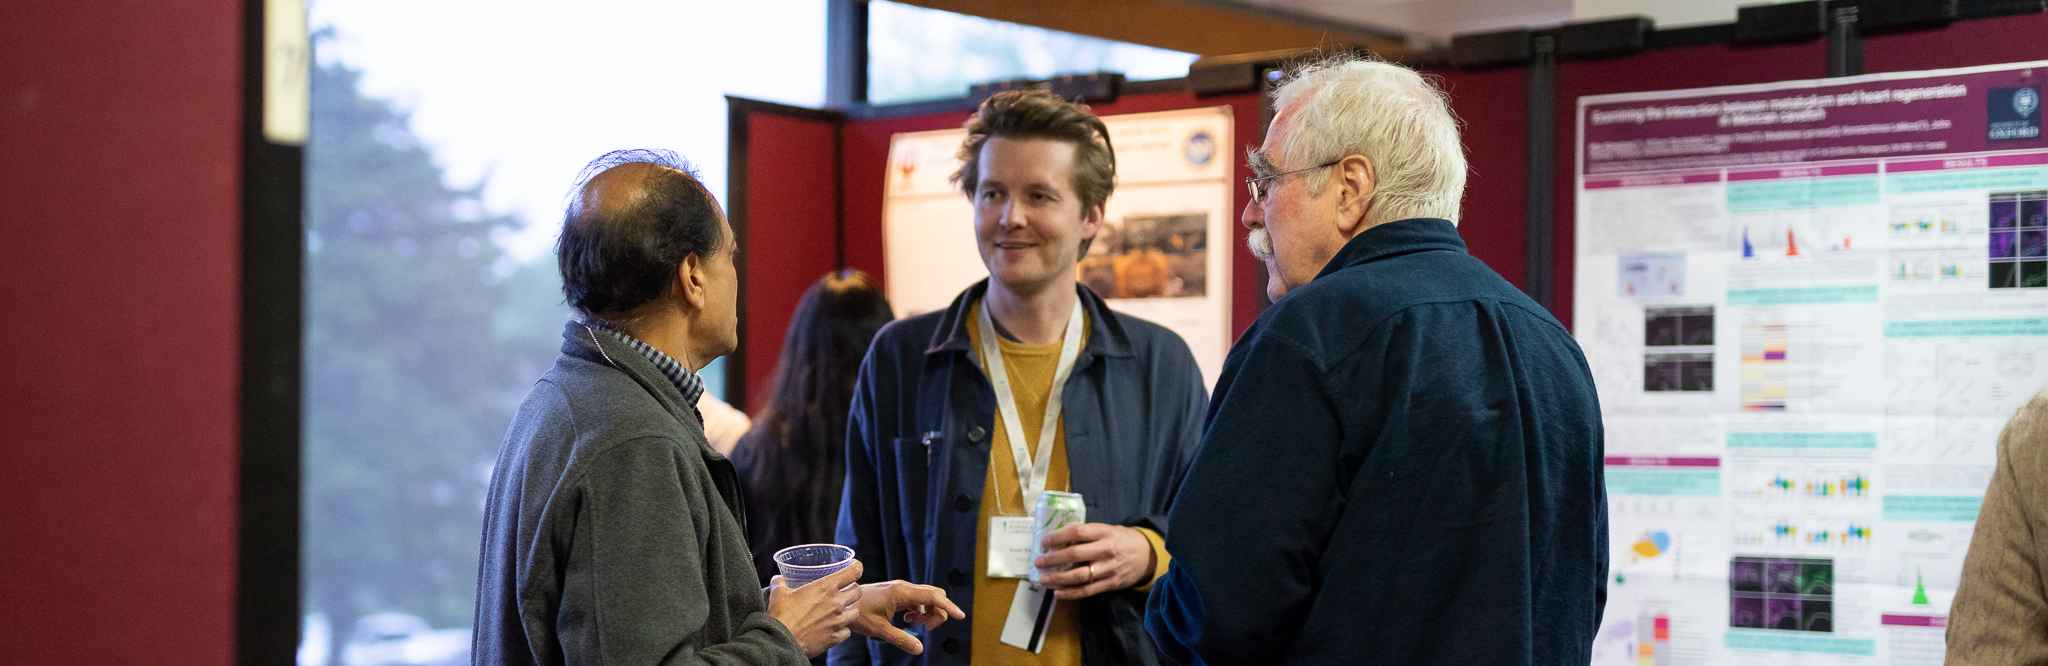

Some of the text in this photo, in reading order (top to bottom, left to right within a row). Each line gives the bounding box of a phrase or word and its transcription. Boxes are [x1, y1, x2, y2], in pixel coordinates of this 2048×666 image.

[1646, 106, 1663, 121] the
[1722, 100, 1769, 116] between
[1836, 91, 1858, 107] and
[1859, 89, 1890, 105] heart
[1891, 83, 1967, 104] regeneration
[1988, 126, 2040, 140] OXFORD
[1943, 156, 1988, 169] RESULTS
